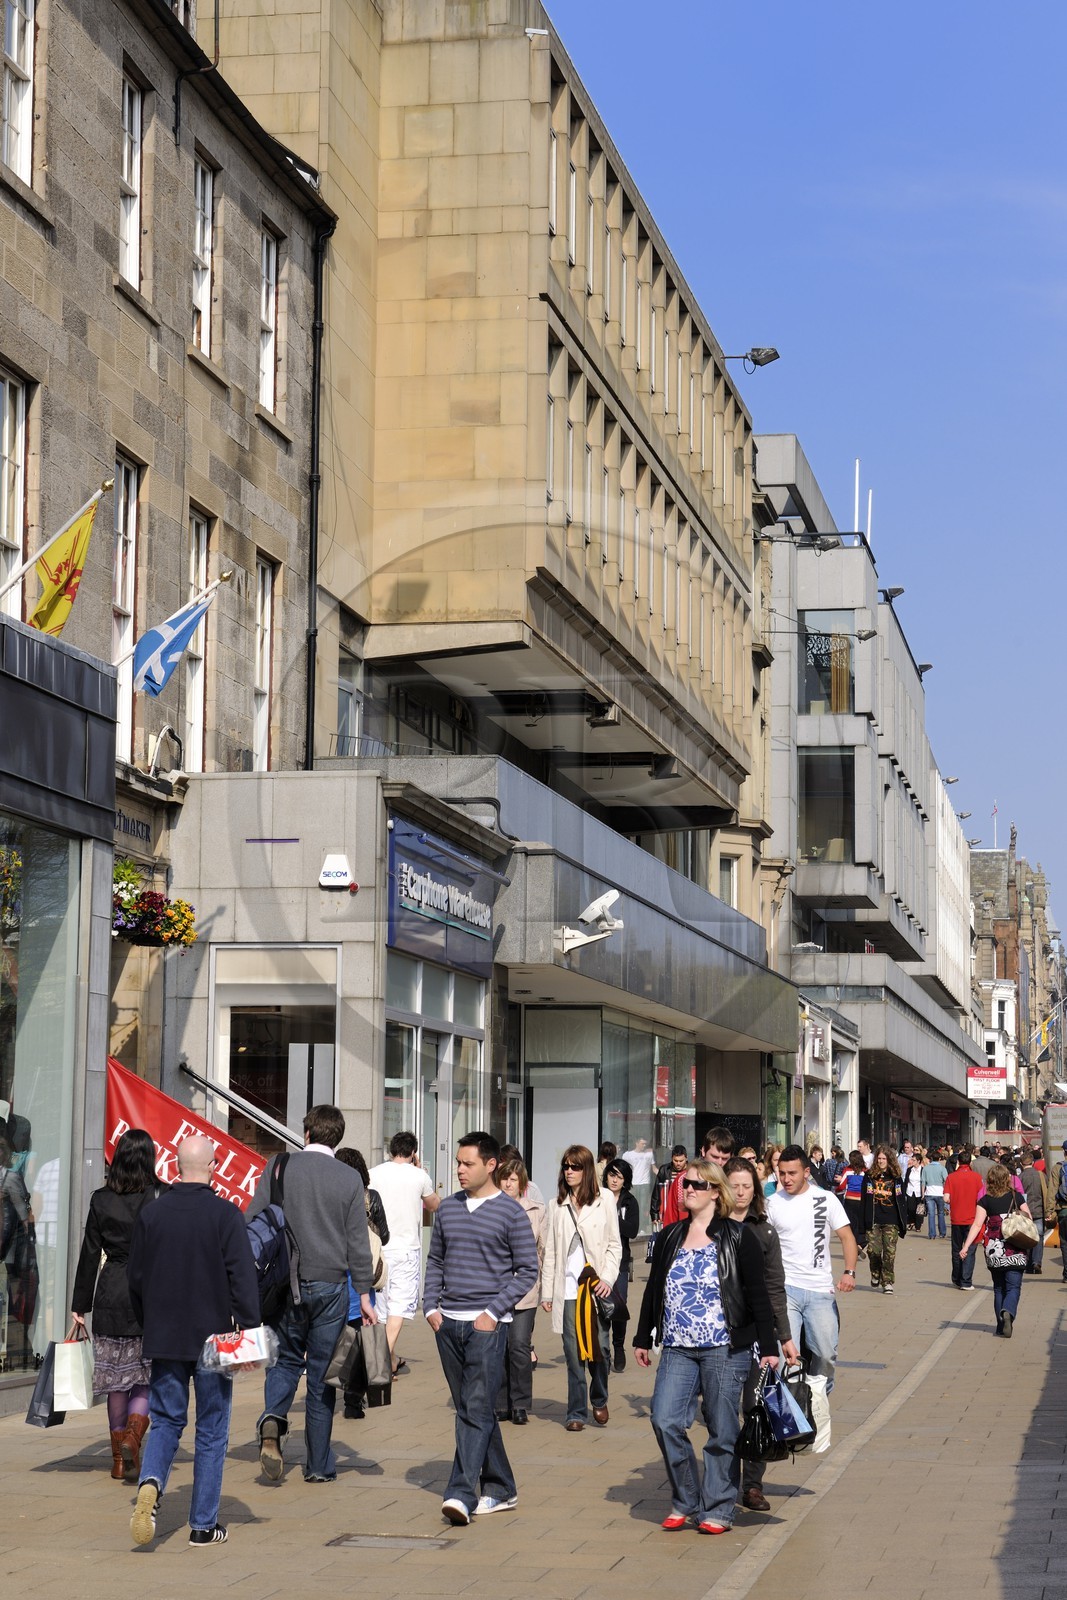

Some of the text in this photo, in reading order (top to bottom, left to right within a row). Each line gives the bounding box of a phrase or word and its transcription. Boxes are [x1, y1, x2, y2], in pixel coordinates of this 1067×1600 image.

[322, 870, 348, 879] SECOM
[407, 866, 448, 911] Carphone
[447, 885, 491, 929] Warehouse
[168, 1118, 238, 1182] FL
[812, 1195, 828, 1269] ANIMAL
